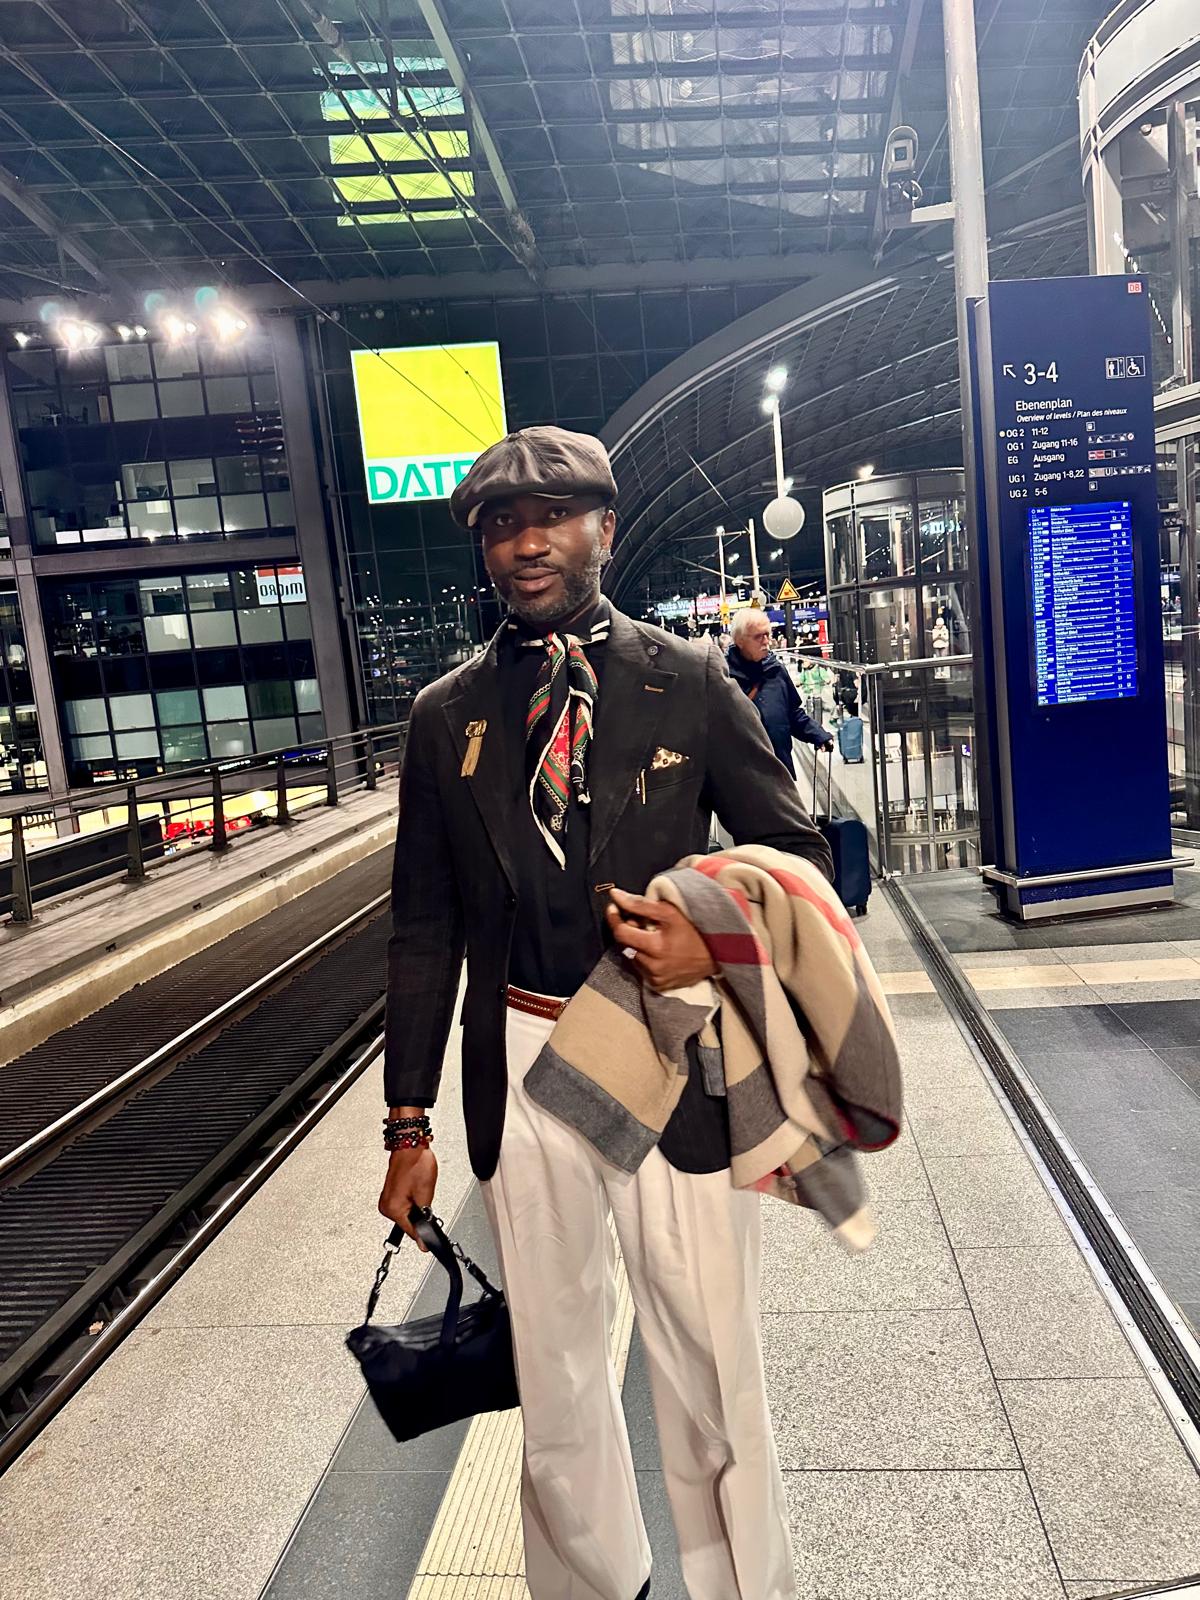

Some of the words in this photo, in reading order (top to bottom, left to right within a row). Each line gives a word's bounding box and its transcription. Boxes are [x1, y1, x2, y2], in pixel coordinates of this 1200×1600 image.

[1024, 362, 1058, 385] 3-4
[1015, 398, 1073, 411] Ebenenplan
[1016, 413, 1045, 423] Overview
[1046, 412, 1052, 420] of
[1019, 429, 1024, 437] 2
[1032, 427, 1049, 436] 11-12
[1032, 441, 1059, 450] Zugang
[1061, 438, 1078, 447] 11-16
[1008, 456, 1019, 464] EG
[1033, 454, 1065, 462] Ausgang
[1009, 475, 1020, 483] UG
[1034, 473, 1061, 482] Zugang
[1063, 469, 1085, 478] 1-8,22
[1010, 490, 1021, 498] UG
[1035, 487, 1048, 496] 5-6
[738, 588, 746, 600] E
